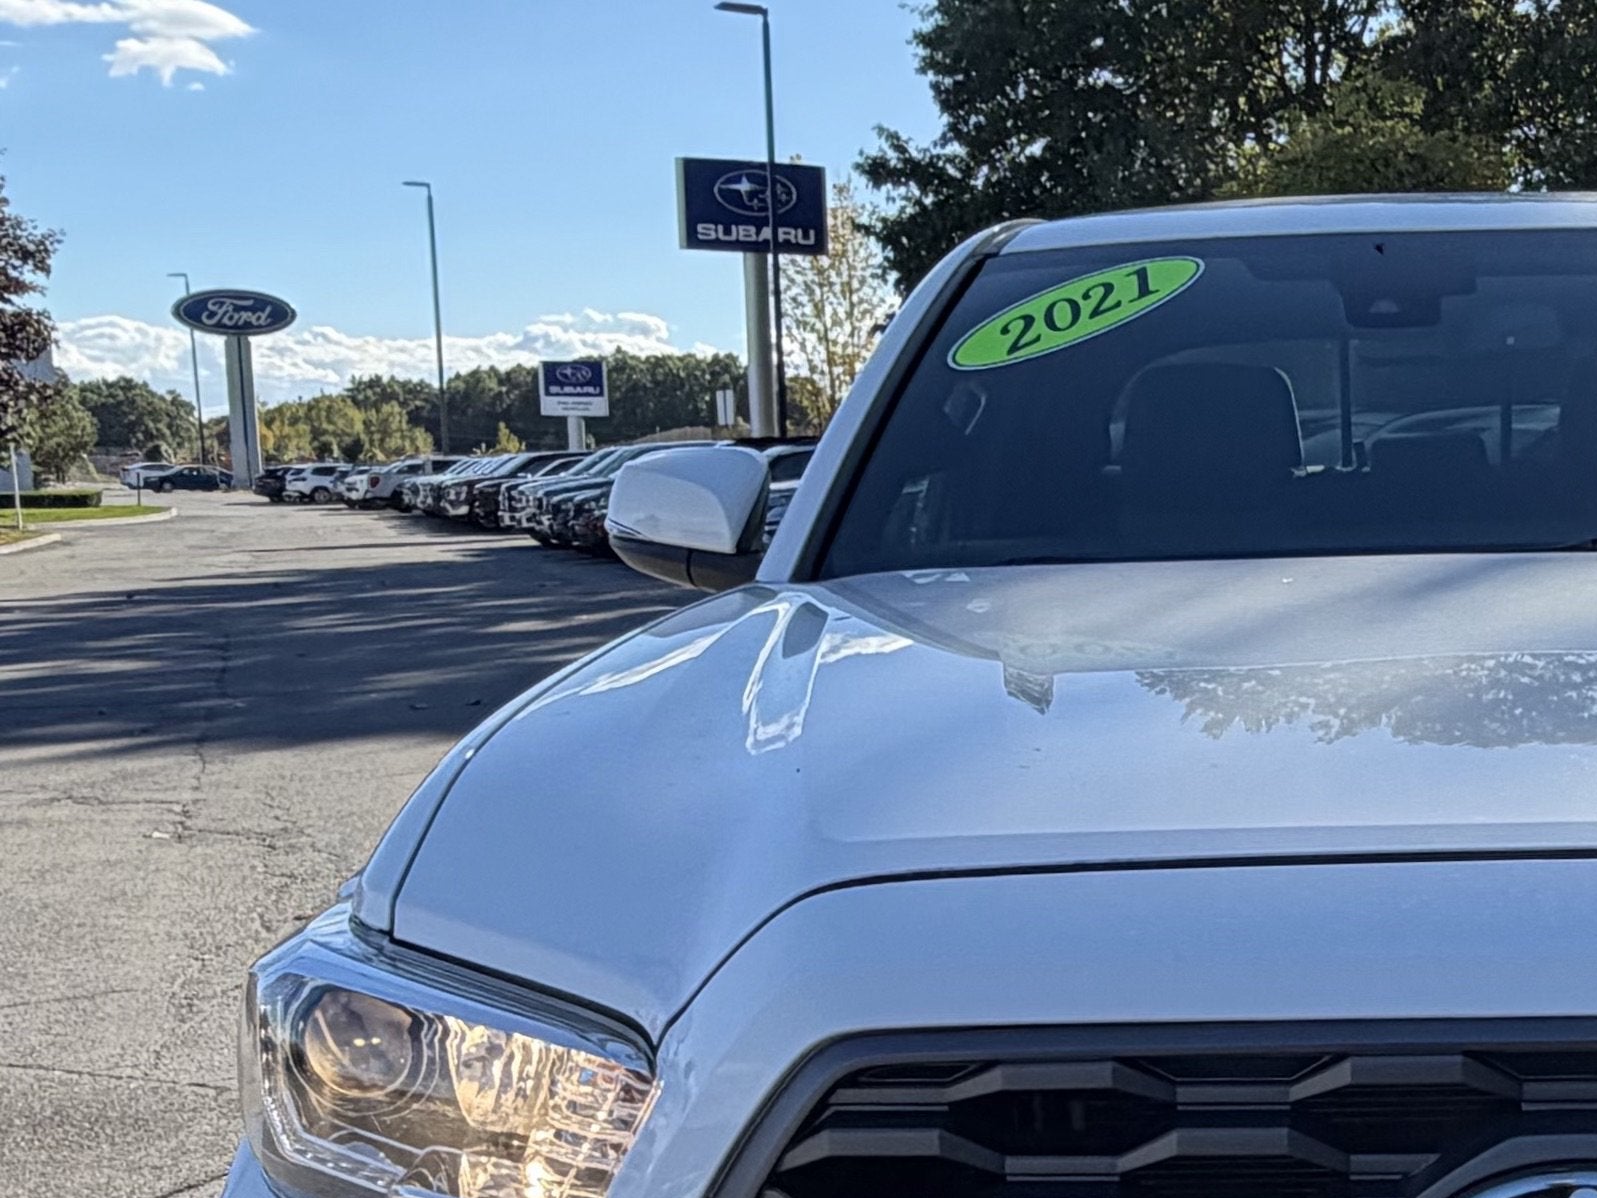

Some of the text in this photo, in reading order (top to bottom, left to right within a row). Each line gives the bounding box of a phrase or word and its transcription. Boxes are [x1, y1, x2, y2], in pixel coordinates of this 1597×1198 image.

[697, 223, 816, 245] SUBARU
[201, 298, 272, 326] Ford
[1000, 266, 1160, 356] 2021
